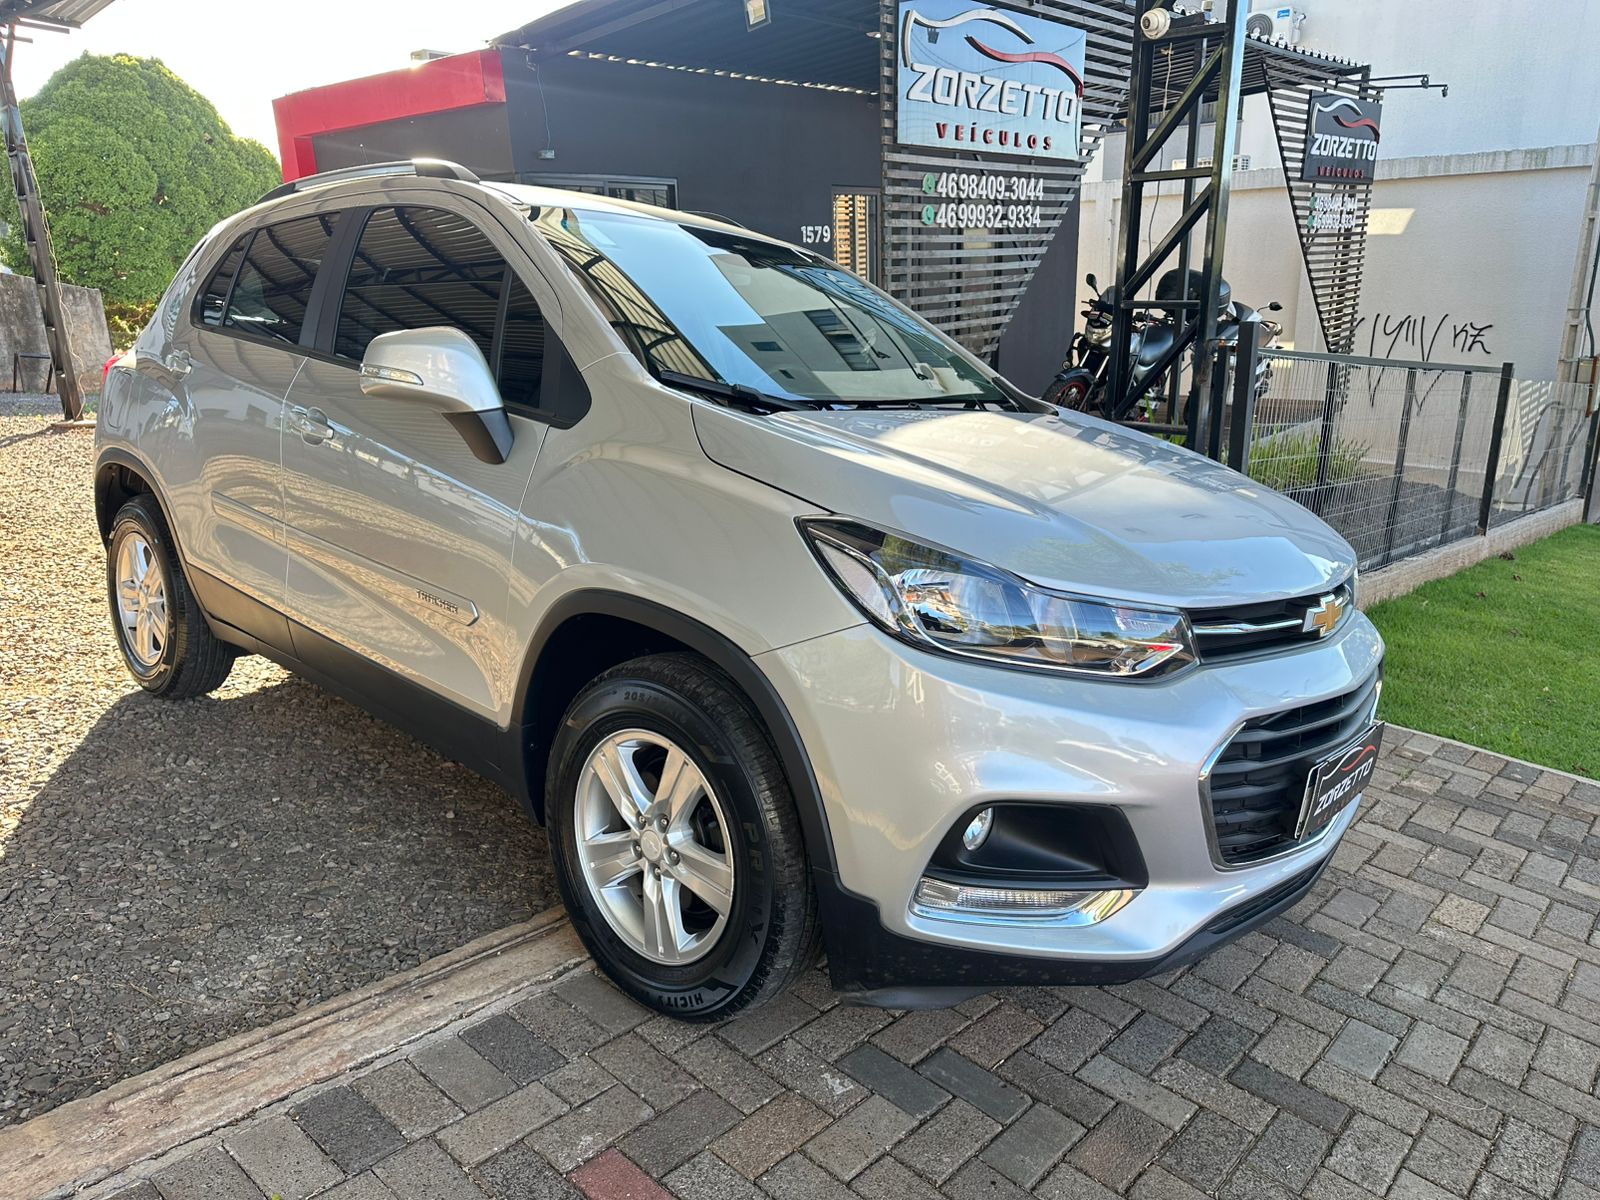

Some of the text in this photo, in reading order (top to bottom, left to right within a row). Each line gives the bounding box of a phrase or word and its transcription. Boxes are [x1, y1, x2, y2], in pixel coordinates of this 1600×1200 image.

[906, 63, 1078, 124] ZORZETTO
[936, 122, 1052, 151] VEÍCULOS
[1310, 133, 1377, 161] ZORZETTO
[799, 225, 831, 244] 1579
[1313, 757, 1374, 817] ZORZETTO
